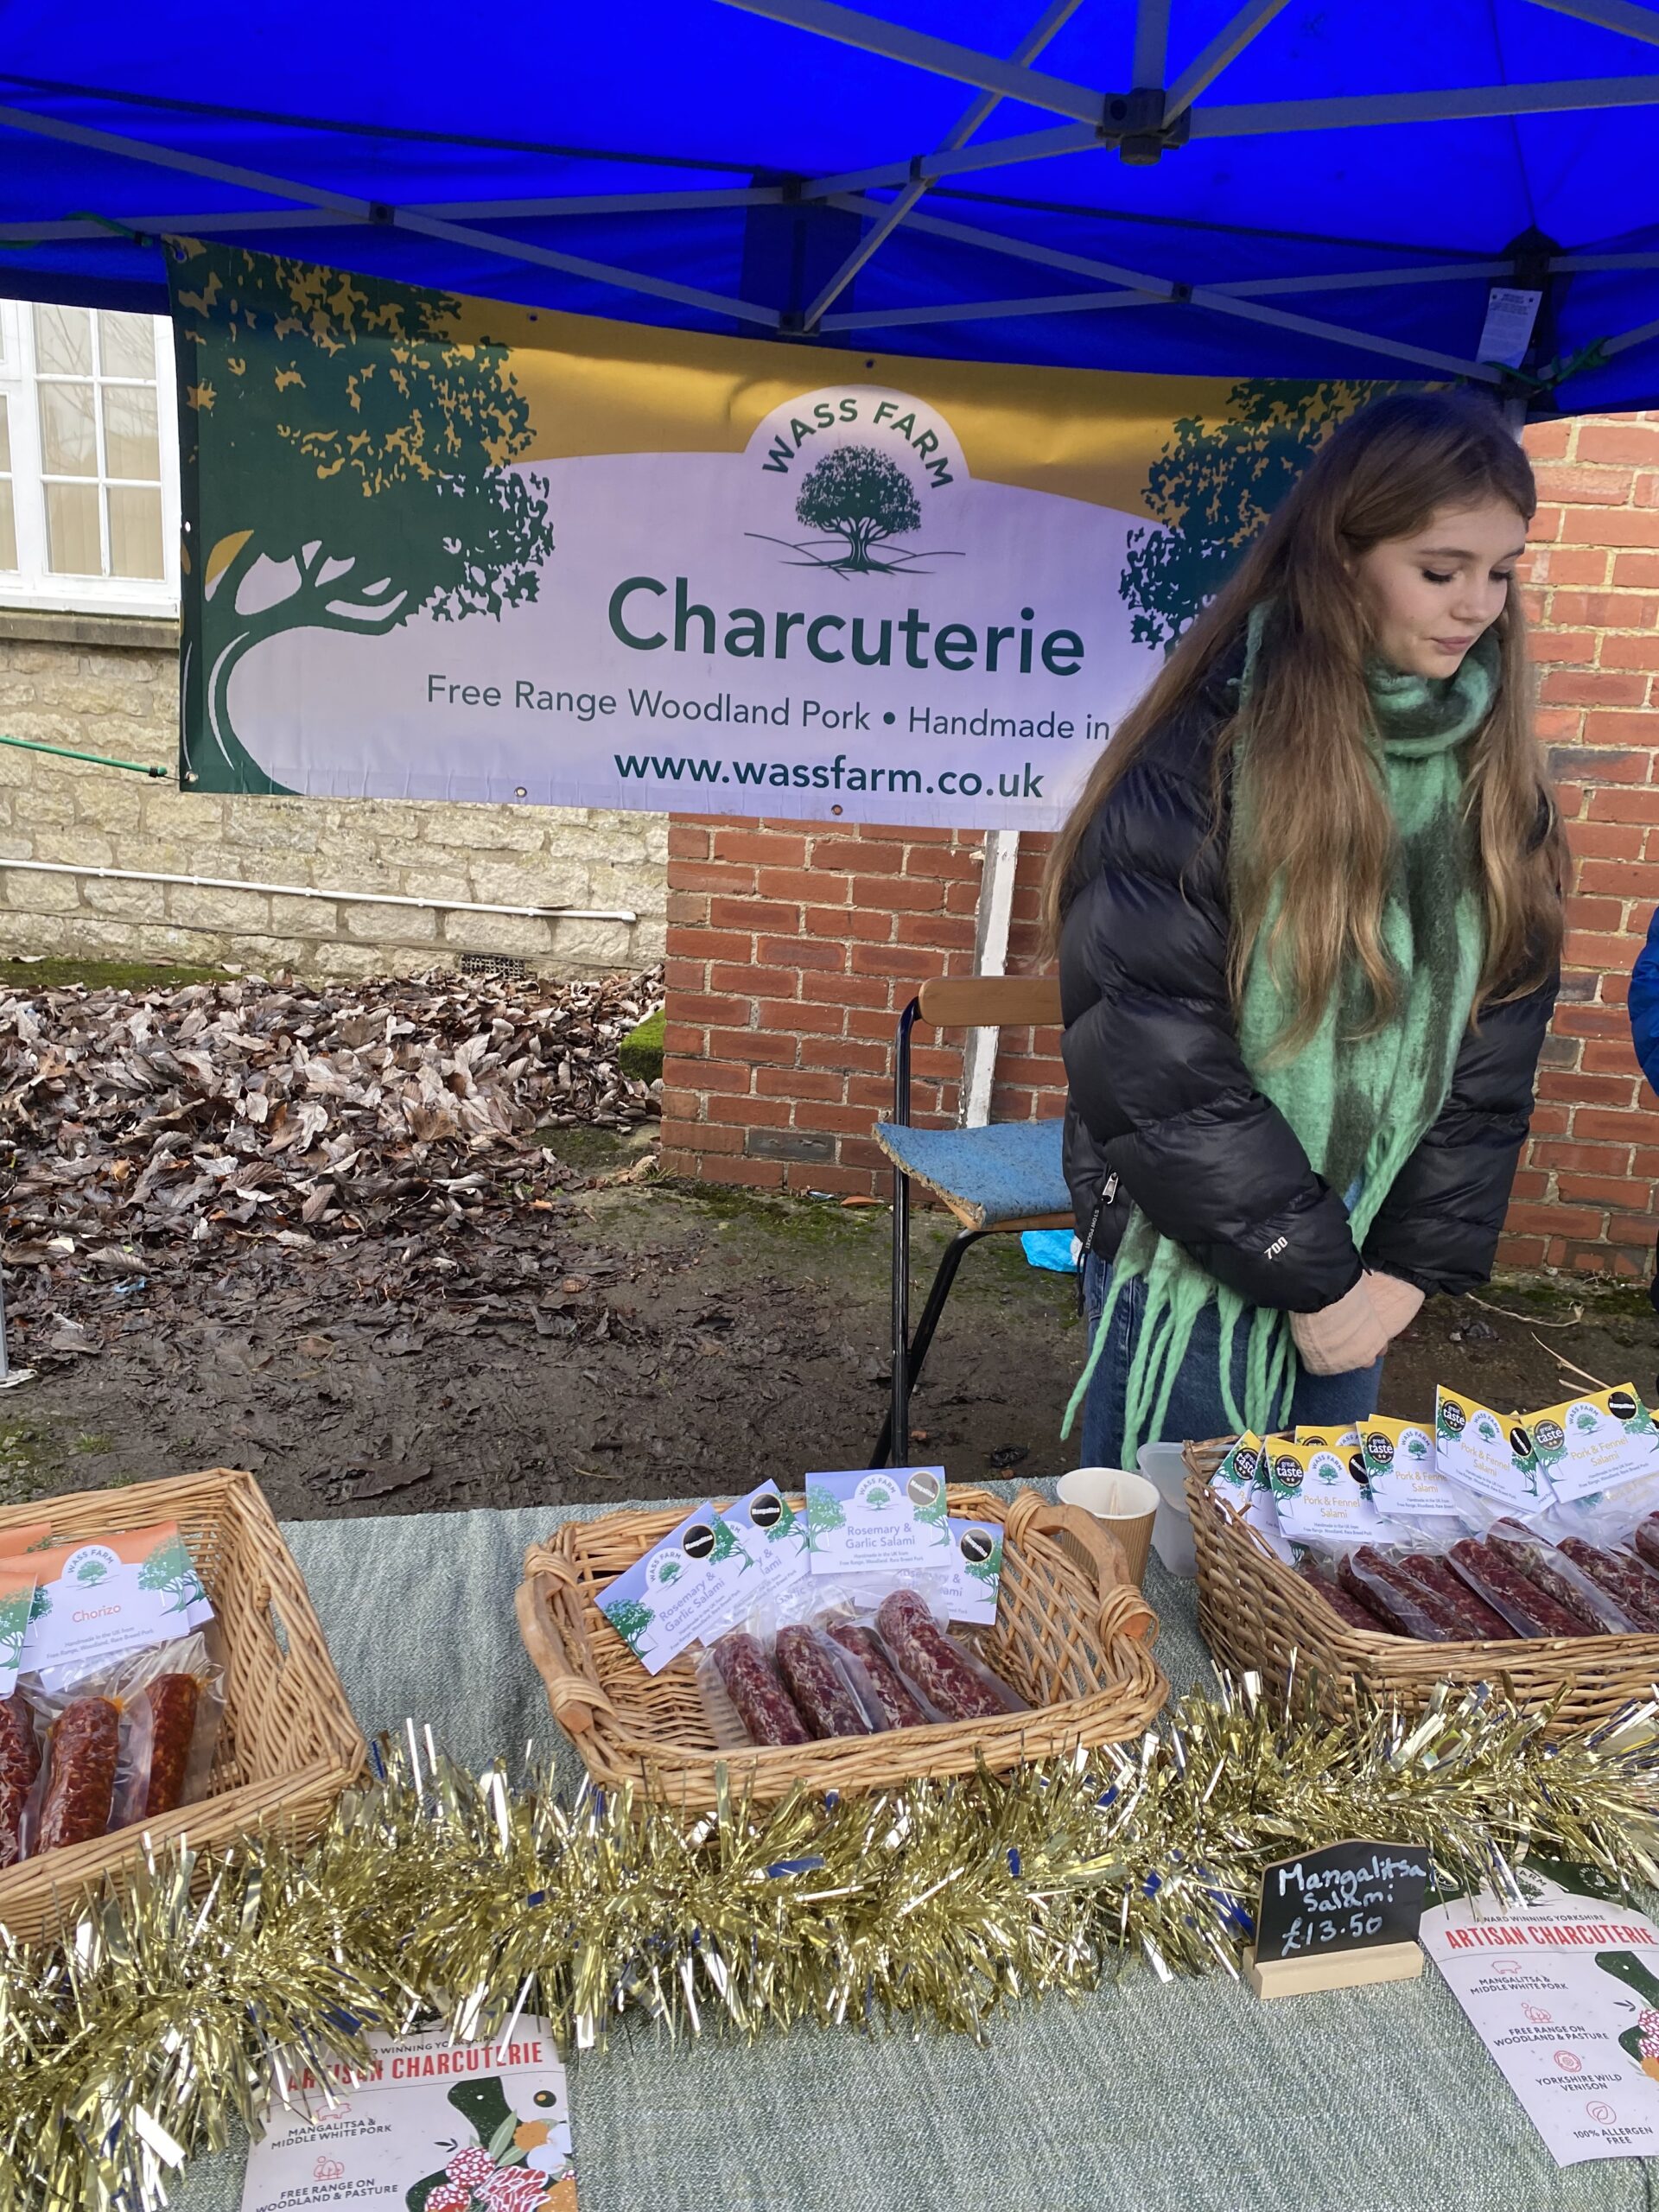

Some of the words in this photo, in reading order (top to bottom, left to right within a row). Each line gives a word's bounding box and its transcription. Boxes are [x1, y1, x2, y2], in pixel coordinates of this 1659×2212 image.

[760, 395, 863, 476] WASS
[872, 399, 955, 492] FARM
[607, 575, 1086, 677] Charcuterie
[426, 674, 502, 709] Free
[514, 679, 617, 723] Range
[627, 688, 791, 729] Woodland
[802, 699, 870, 732] Pork
[907, 705, 1075, 741] Handmade
[1084, 712, 1110, 741] in
[613, 750, 1044, 799] www.wassfarm.co.uk
[1263, 1236, 1288, 1260] 700
[1443, 1409, 1465, 1425] taste
[1448, 1405, 1460, 1414] great
[1569, 1408, 1580, 1424] WASS
[1580, 1405, 1599, 1416] FARM
[1474, 1414, 1485, 1424] WASS
[1486, 1418, 1500, 1433] FARM
[1401, 1431, 1414, 1446] WASS
[1414, 1431, 1430, 1446] FARM
[1536, 1430, 1563, 1444] taste
[1368, 1444, 1393, 1453] taste
[1571, 1448, 1591, 1460] Pork
[1592, 1445, 1599, 1453] &
[1599, 1435, 1629, 1452] Fennel
[1313, 1455, 1325, 1469] WASS
[1326, 1456, 1343, 1471] FARM
[1460, 1442, 1478, 1457] Pork
[1478, 1451, 1484, 1459] &
[1485, 1454, 1510, 1471] Fennel
[1591, 1452, 1619, 1467] Salami
[1276, 1467, 1302, 1477] taste
[1395, 1471, 1414, 1479] Pork
[1414, 1471, 1421, 1480] &
[1422, 1472, 1448, 1481] Fenne
[1473, 1459, 1497, 1477] Salami
[859, 1477, 878, 1496] WASS
[878, 1478, 897, 1494] FARM
[1412, 1483, 1439, 1492] Salami
[1304, 1496, 1323, 1504] Pork
[1325, 1497, 1332, 1506] &
[1332, 1497, 1360, 1507] Fennel
[1320, 1507, 1348, 1518] Salami
[848, 1524, 900, 1538] Rosemary
[904, 1523, 912, 1533] &
[845, 1537, 880, 1549] Garlic
[880, 1535, 916, 1548] Salami
[67, 1551, 88, 1573] WASS
[91, 1548, 114, 1564] FARM
[764, 1548, 773, 1559] &
[651, 1559, 661, 1582] WASS
[660, 1551, 682, 1560] FARM
[953, 1573, 961, 1584] &
[658, 1575, 707, 1623] Rosemary
[706, 1572, 716, 1582] &
[664, 1605, 696, 1633] Garlic
[694, 1578, 725, 1610] Salami
[72, 1604, 122, 1624] Chorizo
[1279, 1855, 1427, 1897] Mangalitsa
[1519, 1870, 1547, 1886] ARM
[1281, 1912, 1382, 1956] £13.50
[1445, 1926, 1529, 1949] ARTISAN
[1528, 1924, 1658, 1945] CHARCUTERIE
[1470, 1984, 1510, 1995] MIDDLE
[1508, 1982, 1541, 1991] WHITE
[1478, 1976, 1541, 1986] MANGALITSA
[1509, 2027, 1535, 2036] FREE
[1493, 2034, 1556, 2047] WOODLAND
[381, 2044, 432, 2054] WINNING
[392, 2042, 543, 2079] CHARCUTERIE
[1535, 2075, 1594, 2086] YORKSHIRE
[1594, 2074, 1622, 2082] WILD
[1560, 2083, 1608, 2092] VENISON
[289, 2120, 365, 2137] MANGALITSA
[1573, 2129, 1599, 2139] 100%
[1601, 2126, 1654, 2137] ALLERGEN
[271, 2134, 316, 2150] MIDDLE
[319, 2130, 357, 2140] WHITE
[360, 2125, 392, 2135] PORK
[1606, 2136, 1632, 2145] FREE
[281, 2188, 308, 2199] FREE
[312, 2181, 353, 2194] RANGE
[356, 2178, 375, 2188] ON
[256, 2194, 331, 2212] WOODLAND
[346, 2185, 398, 2199] PASTURE
